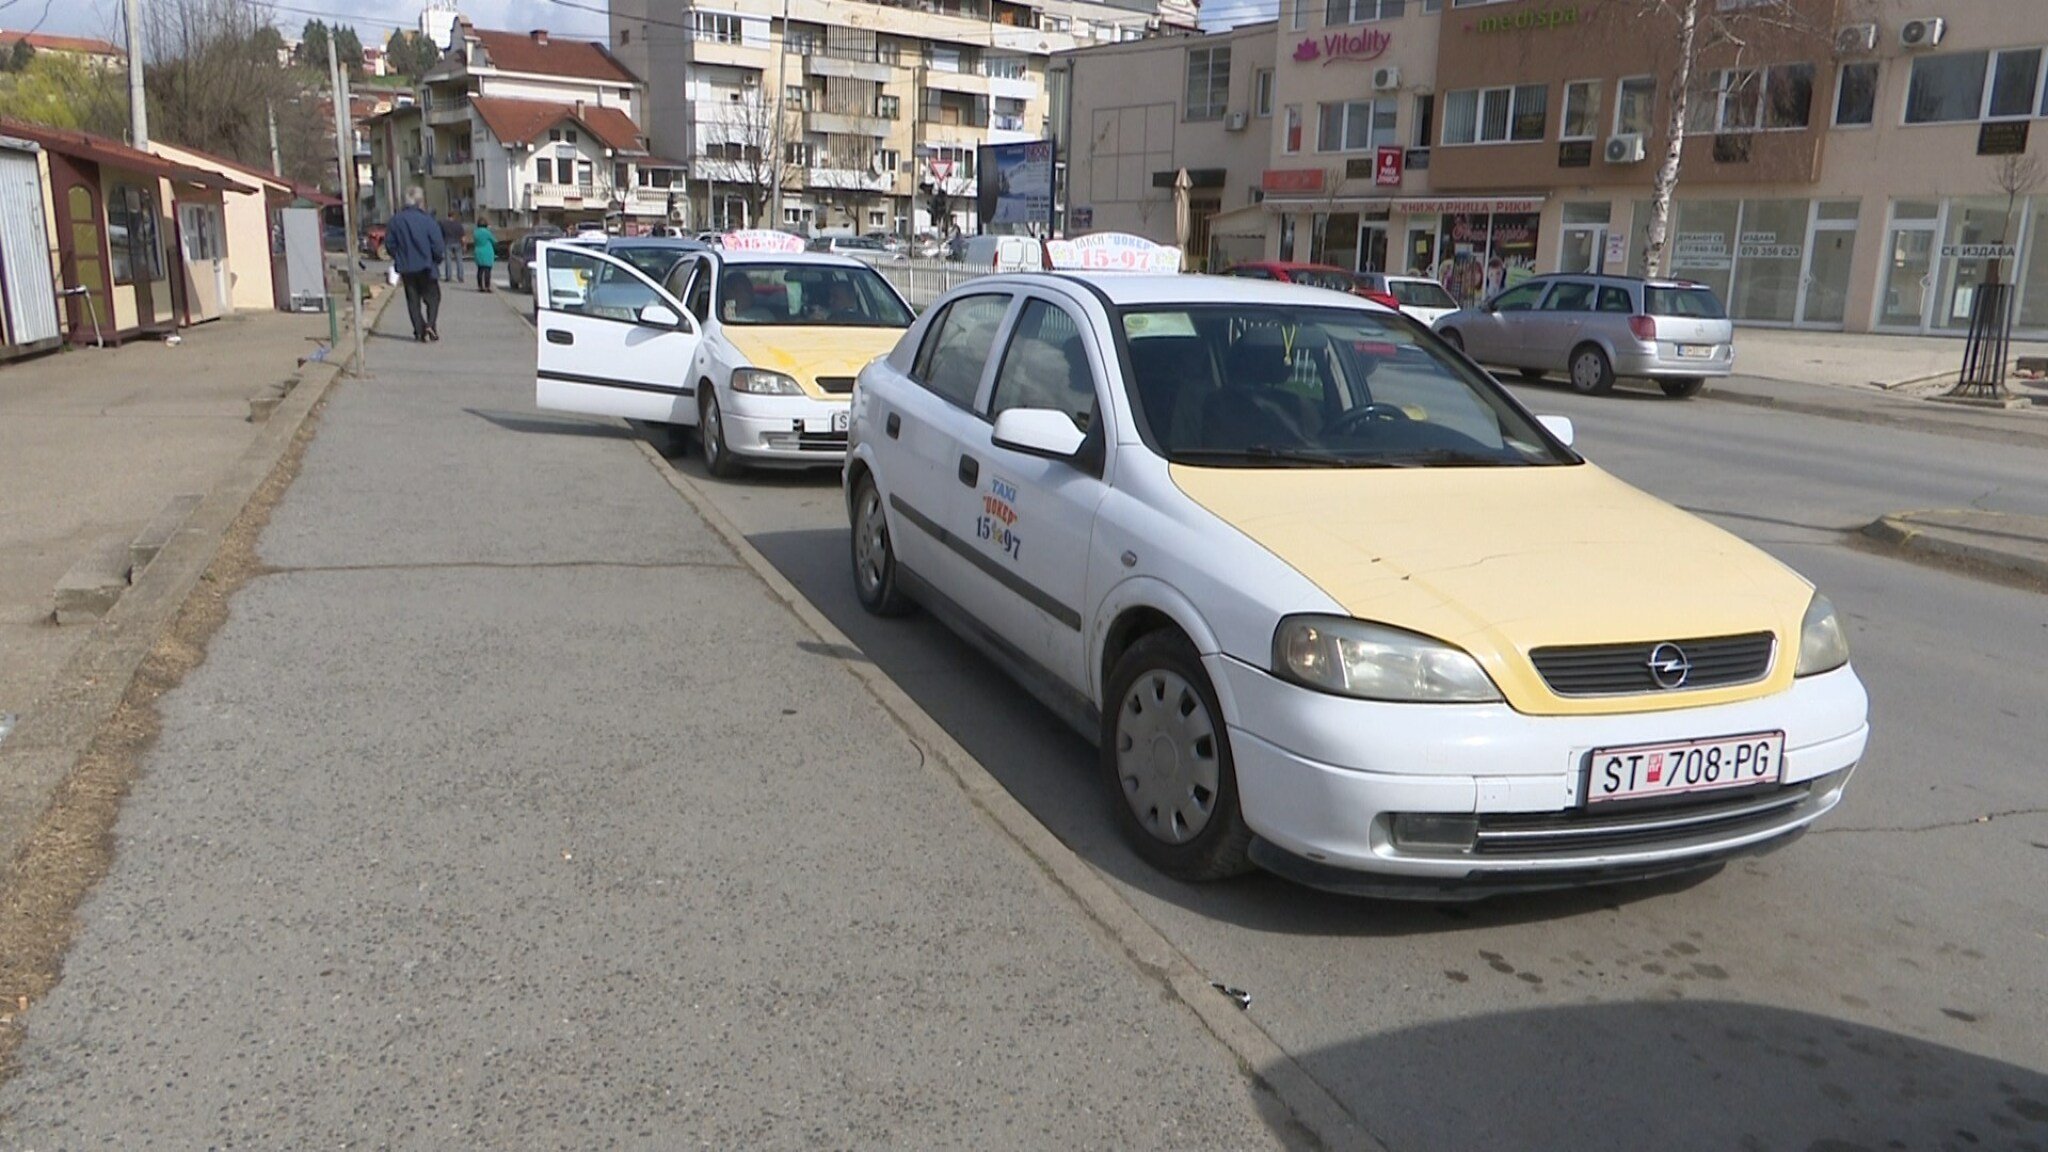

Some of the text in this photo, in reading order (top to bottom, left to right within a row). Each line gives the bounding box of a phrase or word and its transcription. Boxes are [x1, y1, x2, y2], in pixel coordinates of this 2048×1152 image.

[1479, 7, 1577, 33] medispa
[1323, 27, 1391, 62] Vitality
[1400, 201, 1532, 214] КНИЖАРНИЦА РИКИ
[1081, 249, 1150, 269] 15-97
[1942, 246, 2015, 256] СЕ ИЗДАВА
[992, 479, 1016, 503] TAXI
[977, 515, 1021, 560] 15 97
